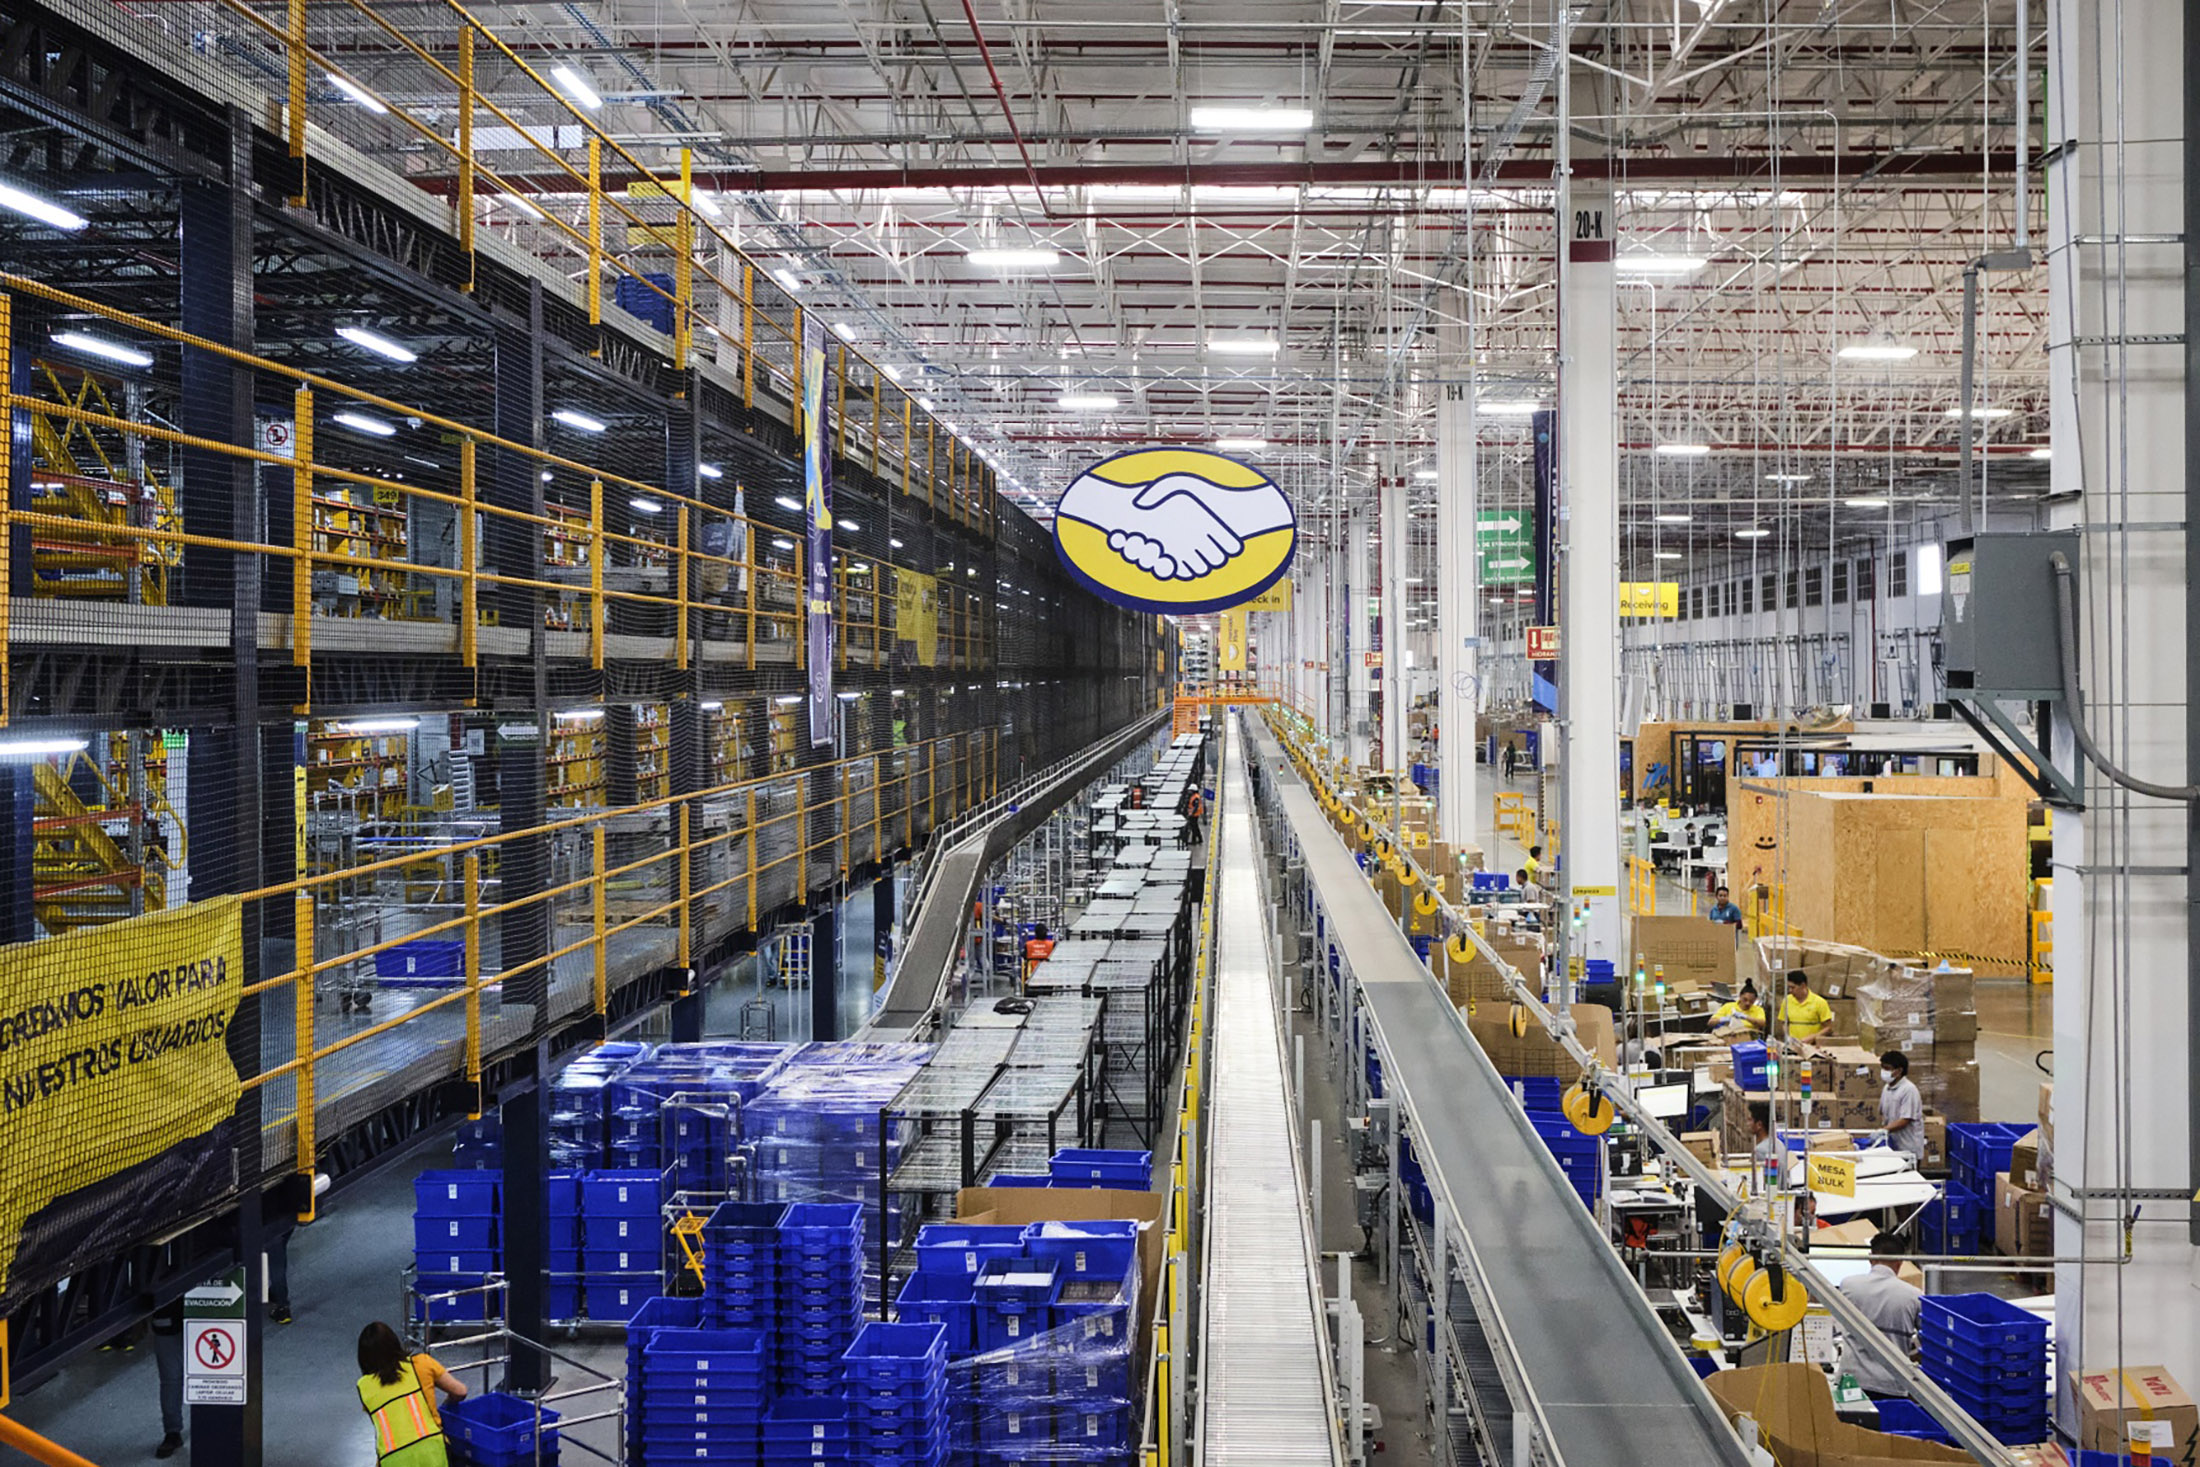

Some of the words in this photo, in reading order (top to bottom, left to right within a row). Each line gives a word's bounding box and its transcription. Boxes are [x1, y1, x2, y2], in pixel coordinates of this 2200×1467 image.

[1576, 211, 1603, 239] 20-K
[1620, 600, 1669, 611] Receiving
[175, 956, 226, 995] PARA
[1818, 1164, 1846, 1176] MESA
